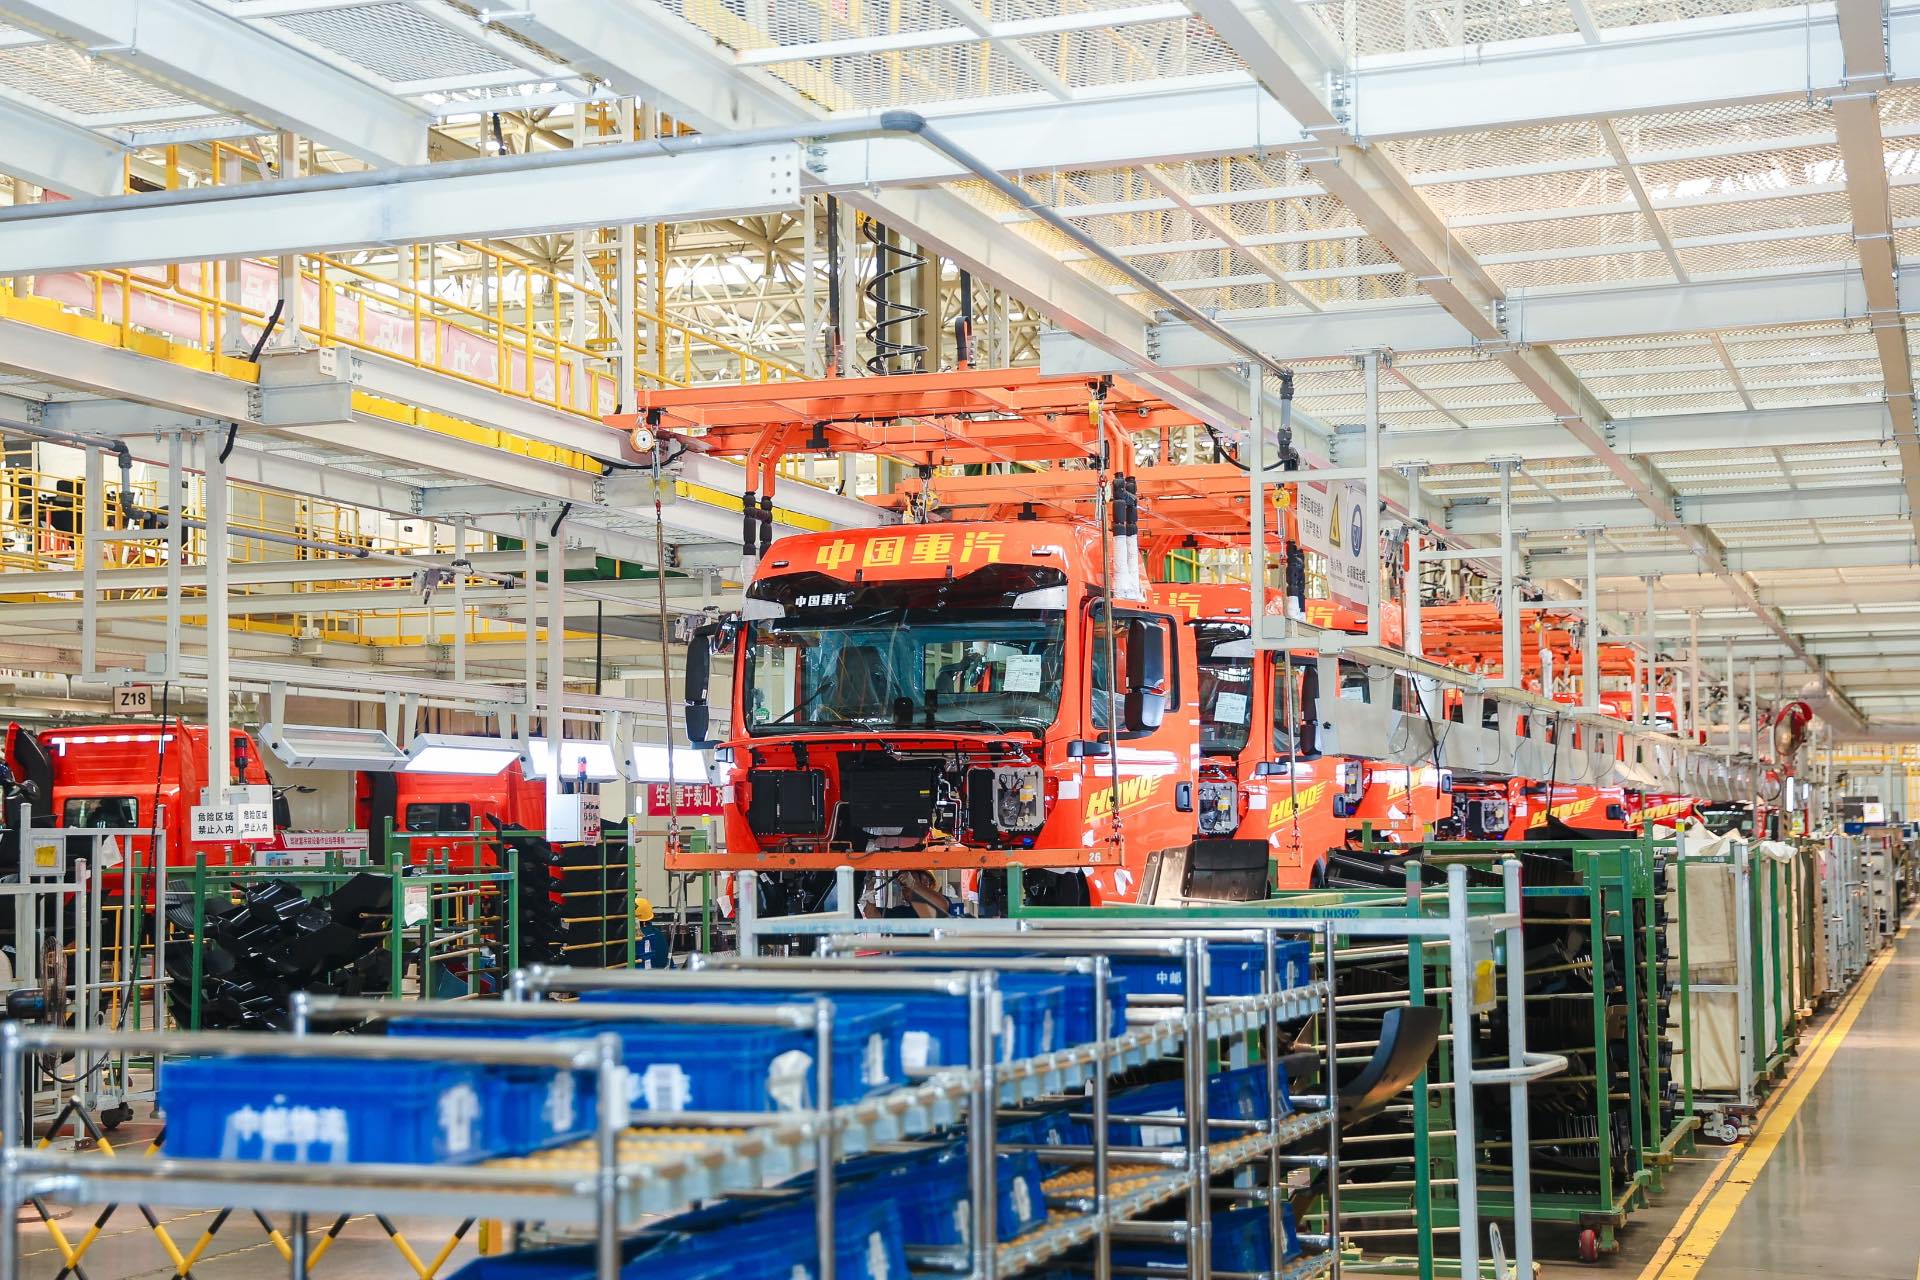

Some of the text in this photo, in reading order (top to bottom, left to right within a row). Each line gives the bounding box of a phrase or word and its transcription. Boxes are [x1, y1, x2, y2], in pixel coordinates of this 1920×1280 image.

[815, 531, 1006, 570] 中国重汽
[795, 593, 847, 608] 中国重汽
[121, 692, 146, 706] Z18
[1268, 782, 1322, 825] HOWO
[198, 812, 234, 822] 危险区域
[243, 810, 268, 820] 危险区域
[198, 825, 234, 834] 禁止入内
[243, 823, 268, 833] 禁止入内
[1088, 852, 1102, 863] 26
